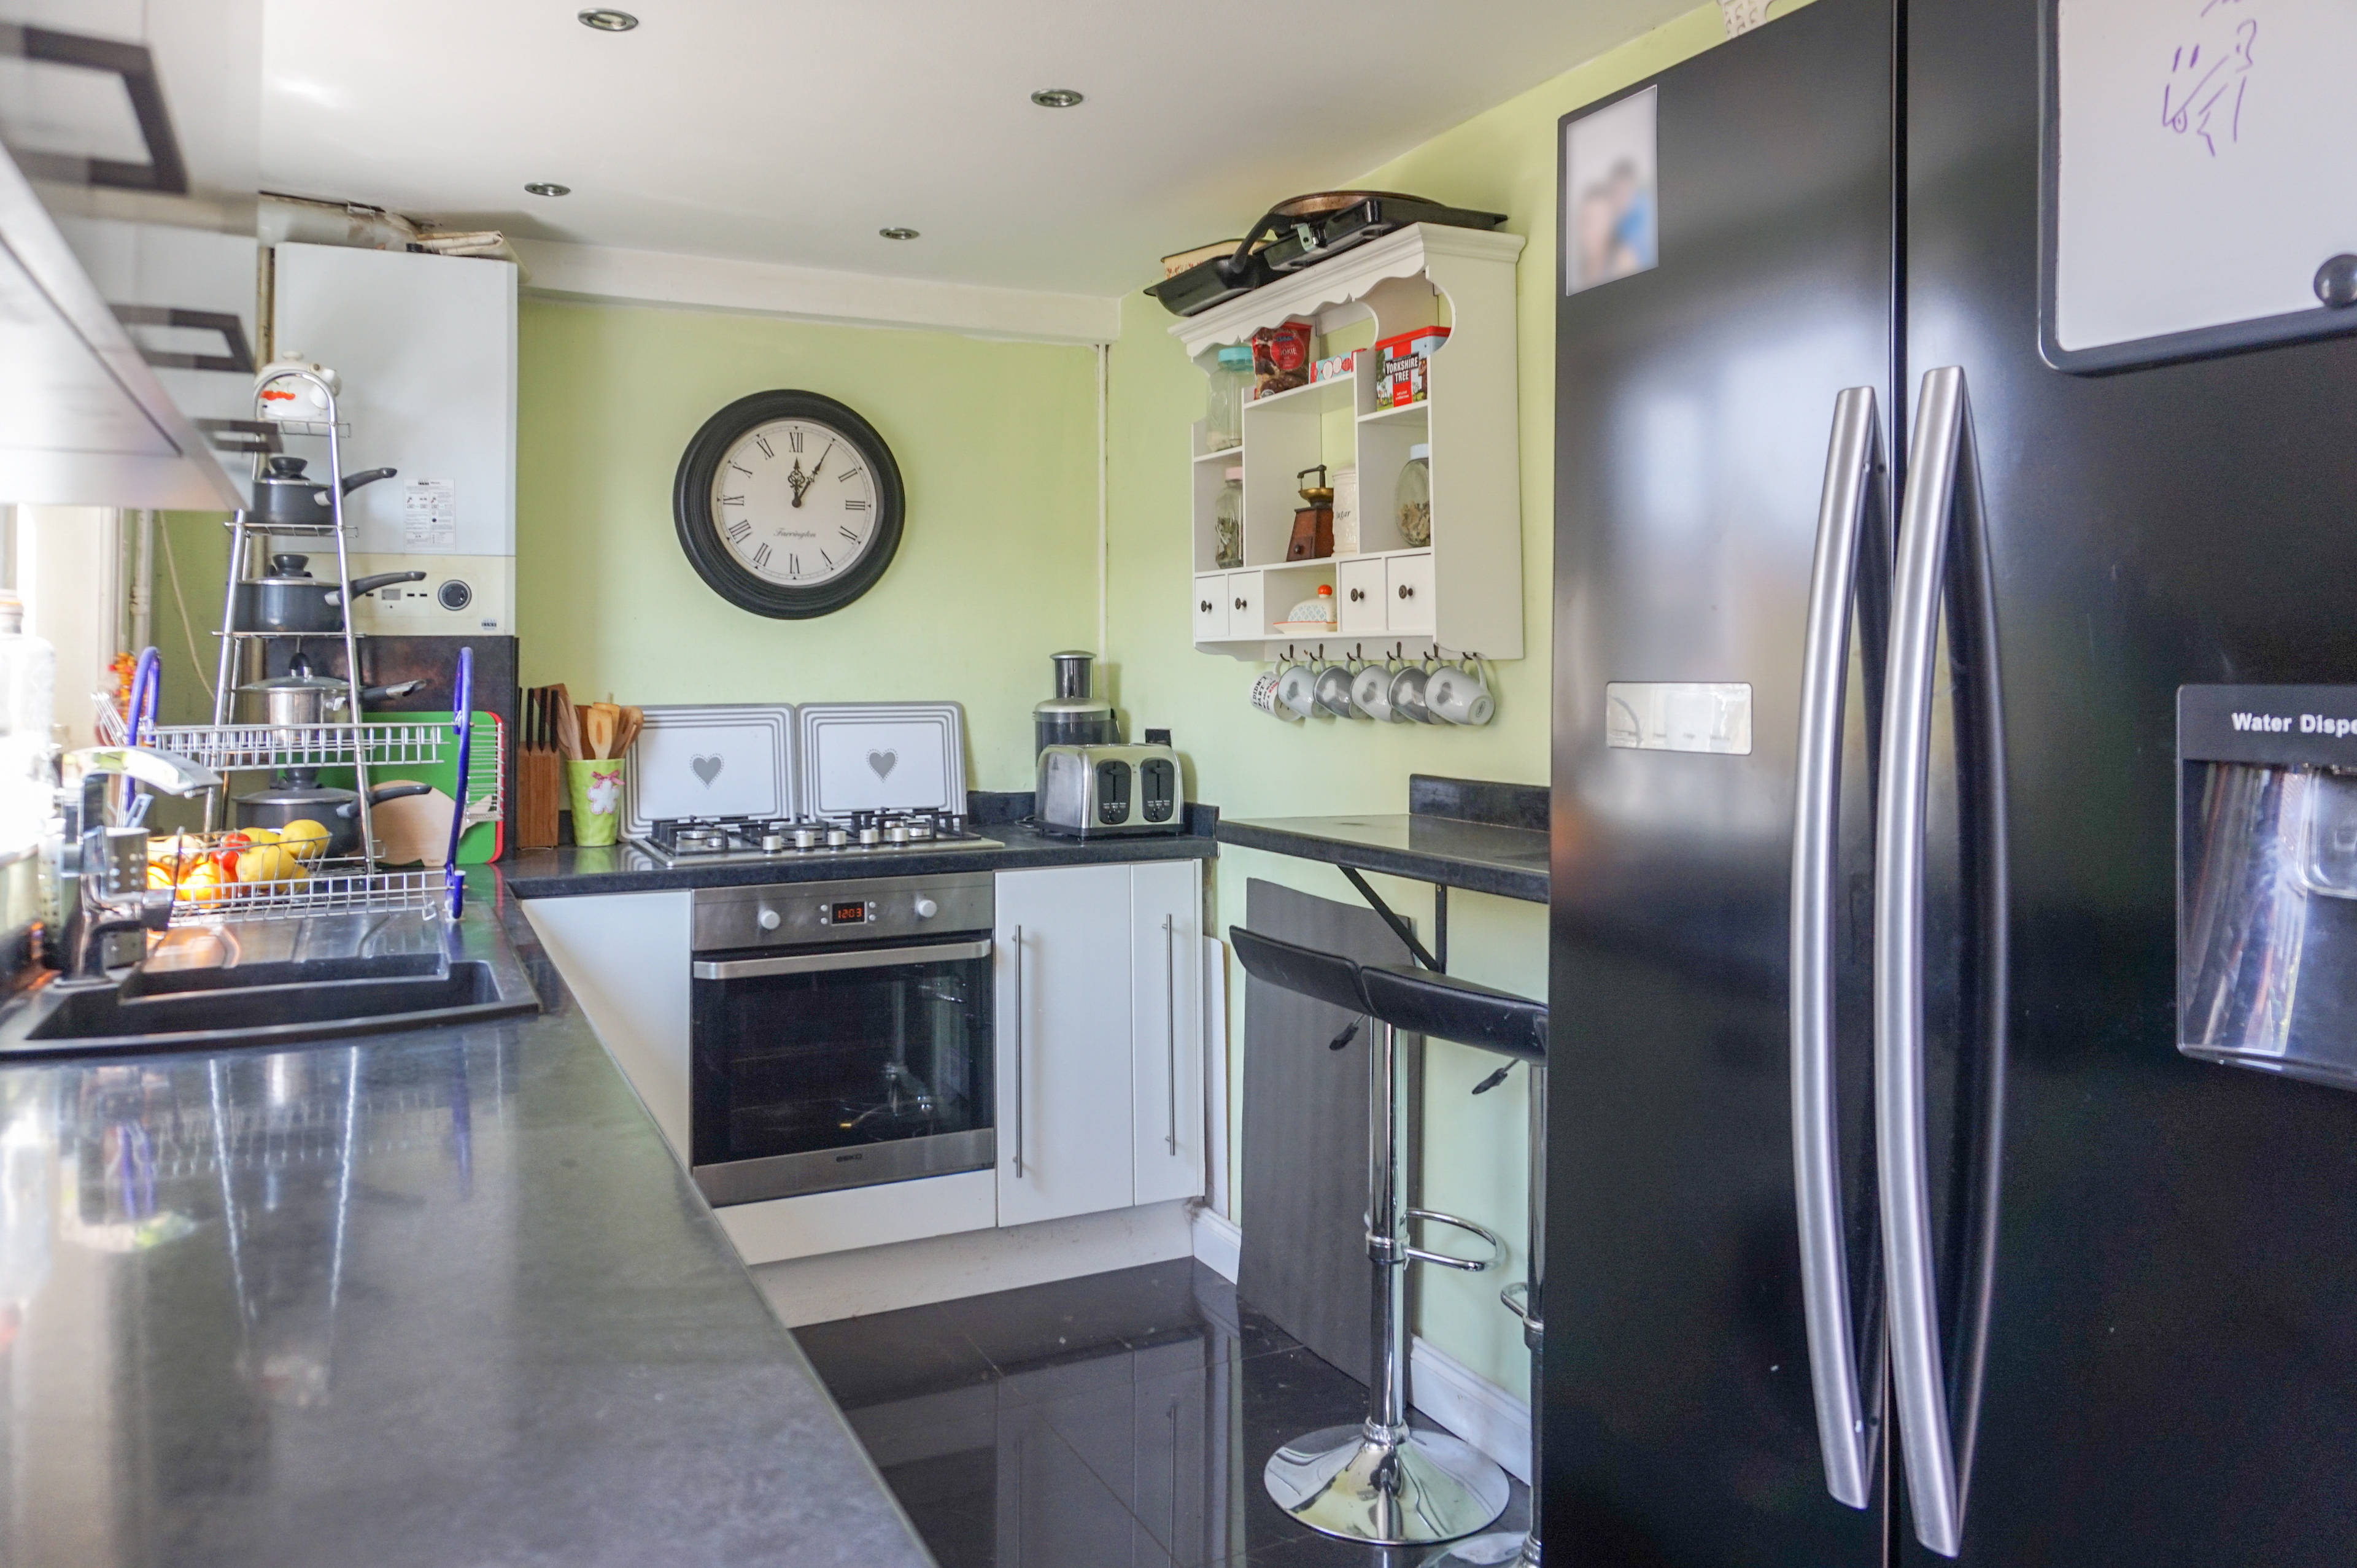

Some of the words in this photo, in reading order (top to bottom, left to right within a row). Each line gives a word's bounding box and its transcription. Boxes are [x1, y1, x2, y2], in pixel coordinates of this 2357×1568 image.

[1385, 356, 1418, 375] YORKSHIRE
[1395, 370, 1409, 383] TREE
[756, 438, 774, 460] XI
[789, 431, 803, 453] XII
[732, 462, 753, 479] X
[838, 468, 858, 482] II
[723, 495, 744, 506] IX
[845, 500, 865, 511] III
[1335, 510, 1351, 520] ugar
[729, 519, 752, 544] VIII
[838, 525, 857, 545] IV
[753, 543, 772, 567] VII
[789, 553, 800, 574] VI
[820, 547, 832, 568] V
[2231, 712, 2293, 732] Water
